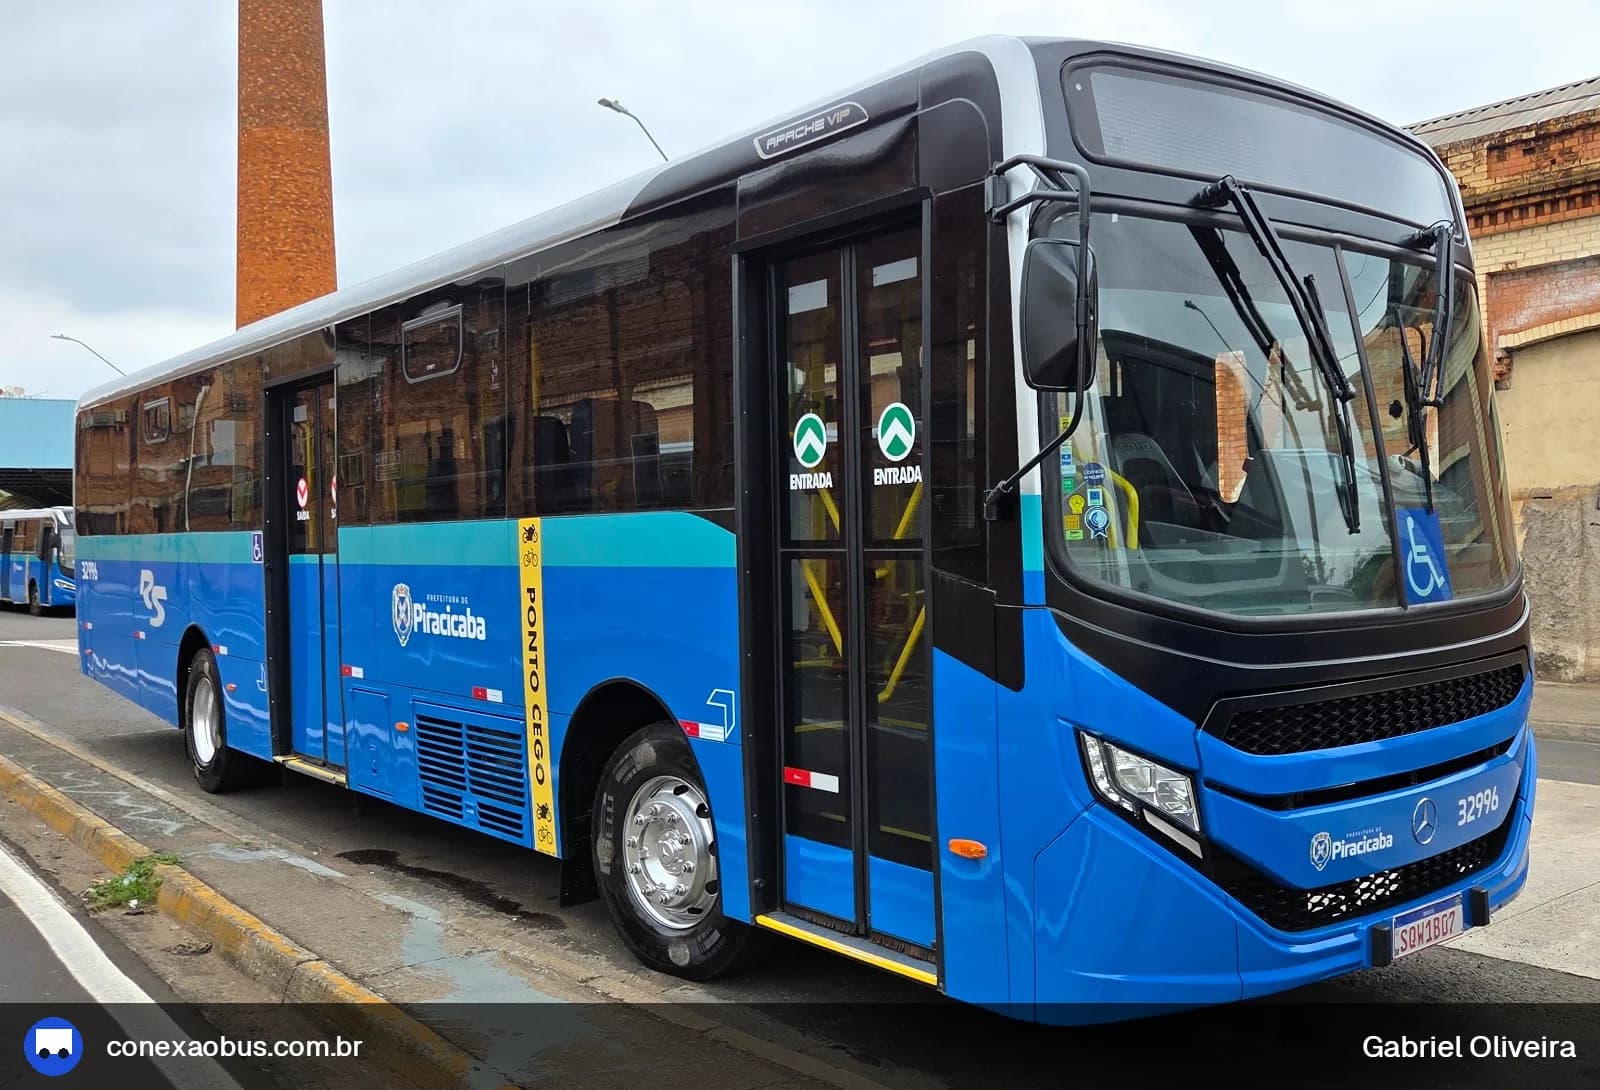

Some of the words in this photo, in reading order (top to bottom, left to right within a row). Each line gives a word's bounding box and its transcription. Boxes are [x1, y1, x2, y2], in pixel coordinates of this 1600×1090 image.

[766, 118, 825, 150] APACHE
[827, 108, 851, 126] VIP
[789, 471, 833, 490] ENTRADA
[874, 465, 923, 486] ENTRADA
[81, 561, 99, 581] 32996
[426, 593, 459, 604] PREFEITURA
[413, 602, 487, 641] Piracicaba
[526, 587, 540, 692] PONTO
[532, 703, 545, 786] CEGO
[1458, 785, 1499, 826] 32996
[1331, 831, 1393, 861] Piracicaba
[1400, 910, 1456, 953] SQW1B07
